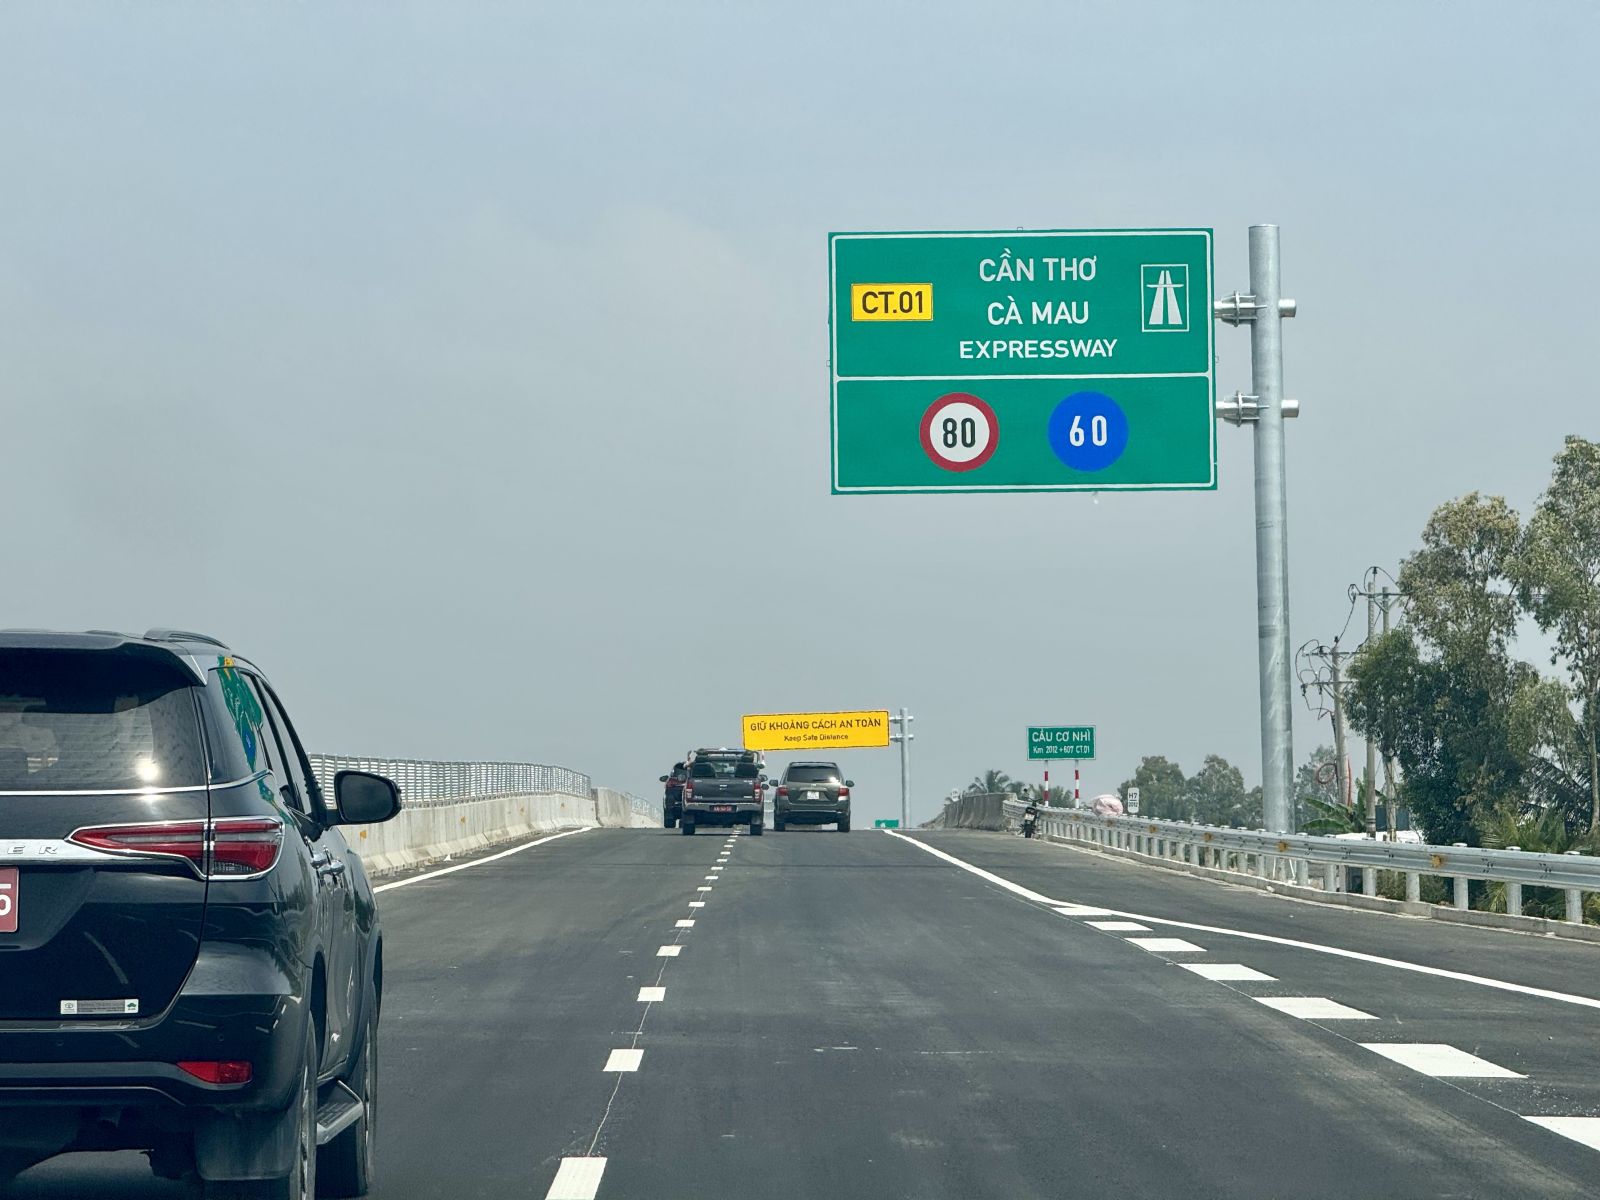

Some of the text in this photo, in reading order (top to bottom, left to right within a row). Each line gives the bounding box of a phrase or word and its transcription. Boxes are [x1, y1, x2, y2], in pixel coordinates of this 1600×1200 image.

[979, 248, 1097, 282] CẦN THƠ
[862, 290, 924, 314] CT.01
[987, 296, 1089, 325] CÀ MAU
[959, 339, 1118, 359] EXPRESSWAY
[943, 417, 976, 448] 80
[1069, 415, 1108, 446] 60
[811, 718, 837, 729] CÁCH
[839, 719, 853, 728] AN
[856, 717, 881, 727] TOÀN
[1055, 731, 1070, 742] CƠ
[1032, 745, 1044, 754] Km
